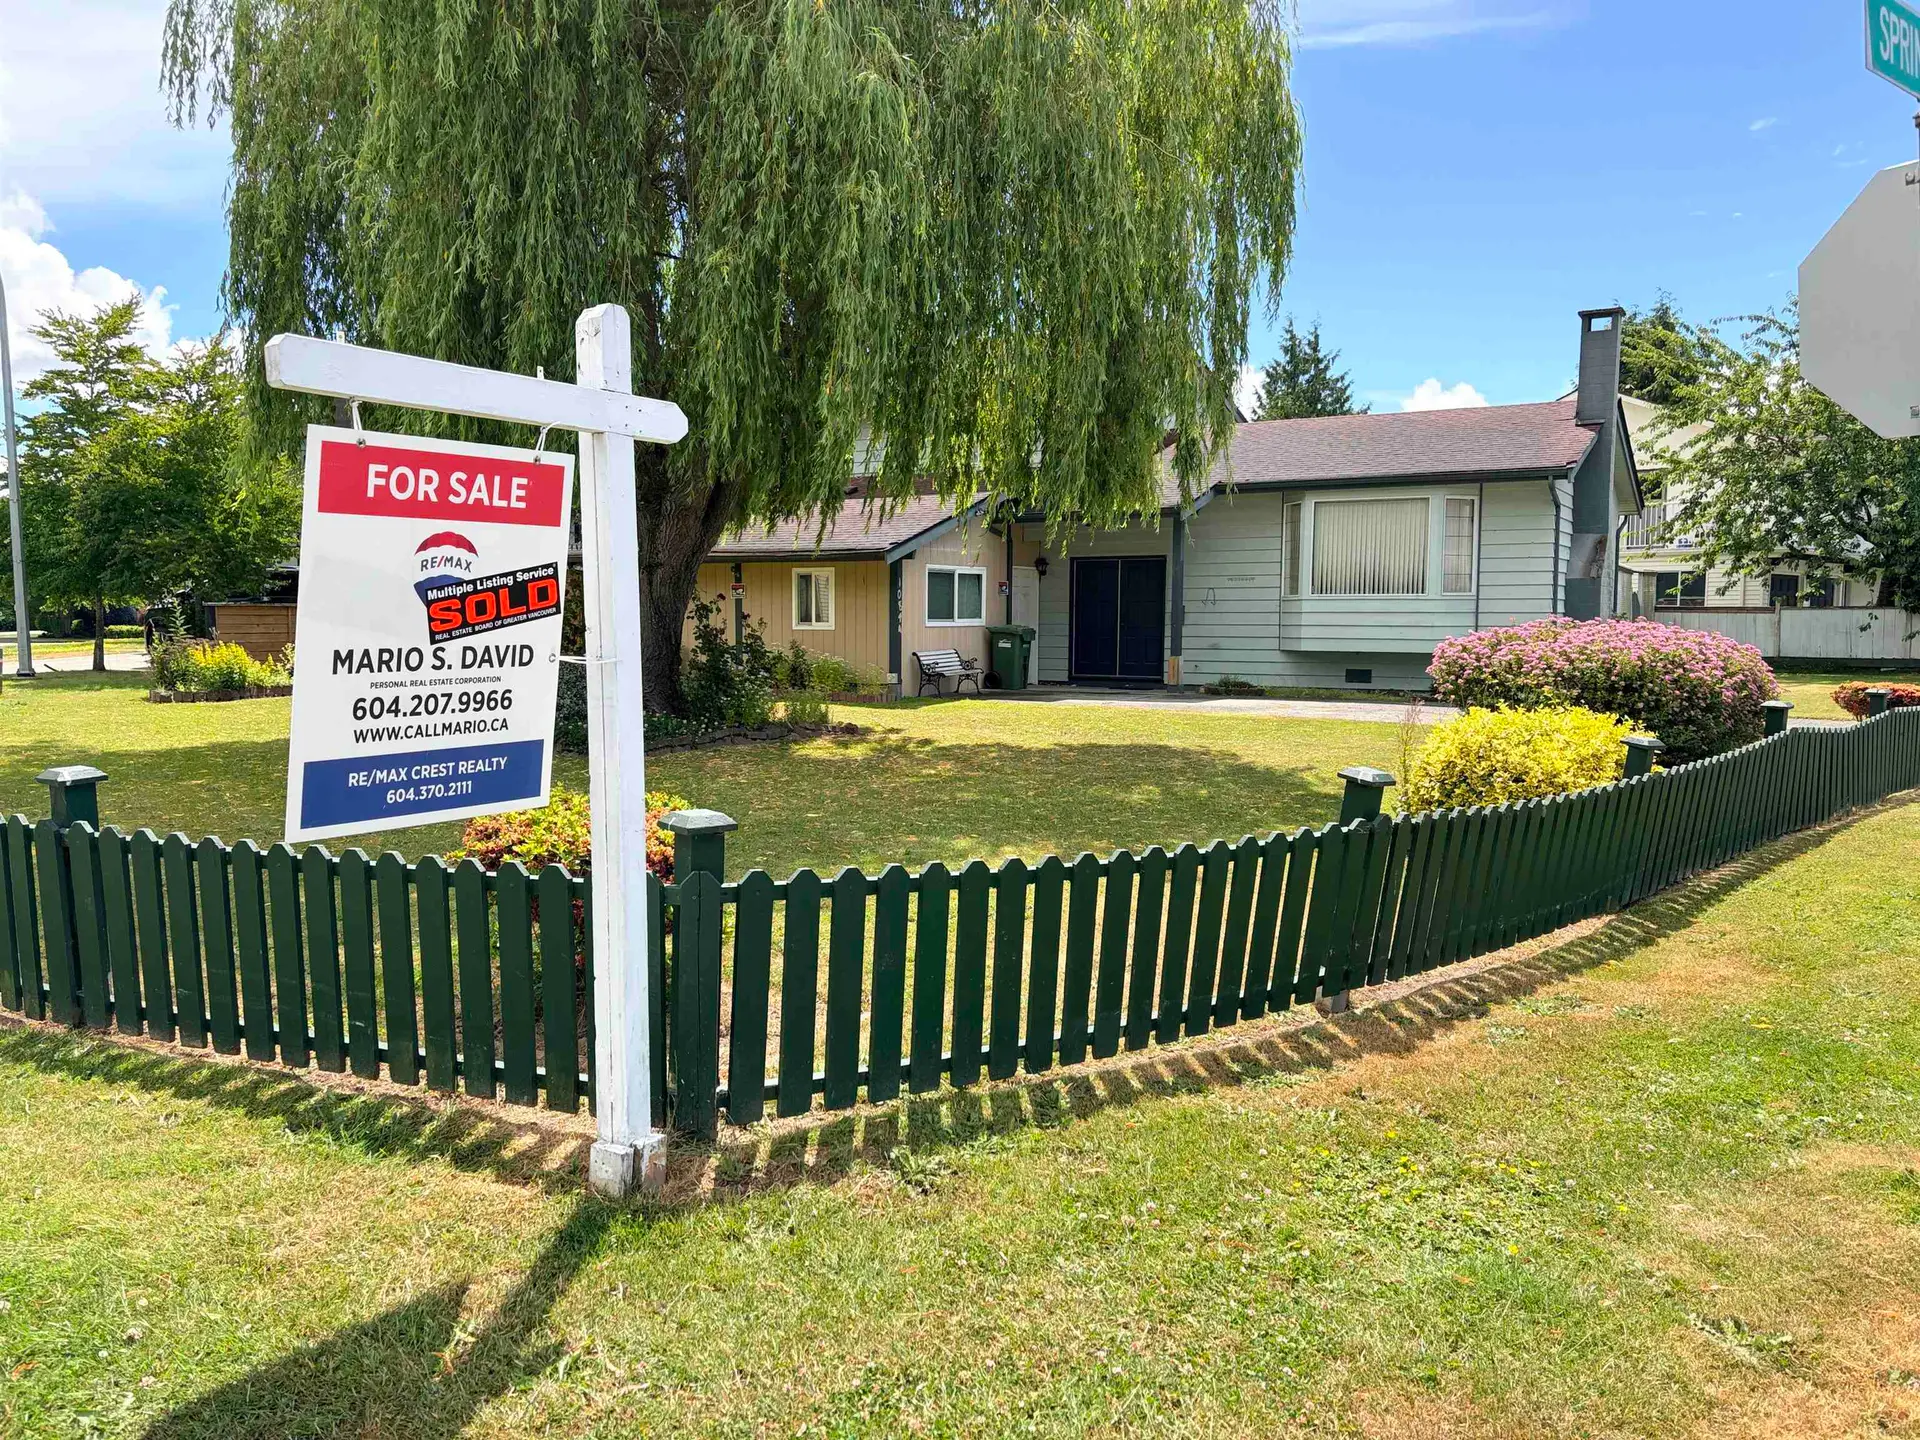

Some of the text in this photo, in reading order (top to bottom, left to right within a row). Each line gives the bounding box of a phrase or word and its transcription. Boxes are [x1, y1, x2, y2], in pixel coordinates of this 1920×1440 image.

[366, 463, 528, 509] FOR SALE
[420, 555, 472, 573] RE/MAX
[427, 566, 554, 600] Multiple Listing Service
[429, 578, 558, 632] SOLD
[435, 607, 557, 641] REAL ESTATE BOARD OF GREATER VANCOUVER
[332, 644, 534, 675] MARIO S. DAVID
[370, 676, 502, 689] PERSONAL REAL ESTATE CORPORATION
[352, 688, 513, 721] 604.207.9966
[353, 717, 509, 744] WWW.CALLMARIO.CA
[348, 756, 508, 788] RE/MAX CREST REALTY
[386, 780, 472, 804] 604.370.2111
